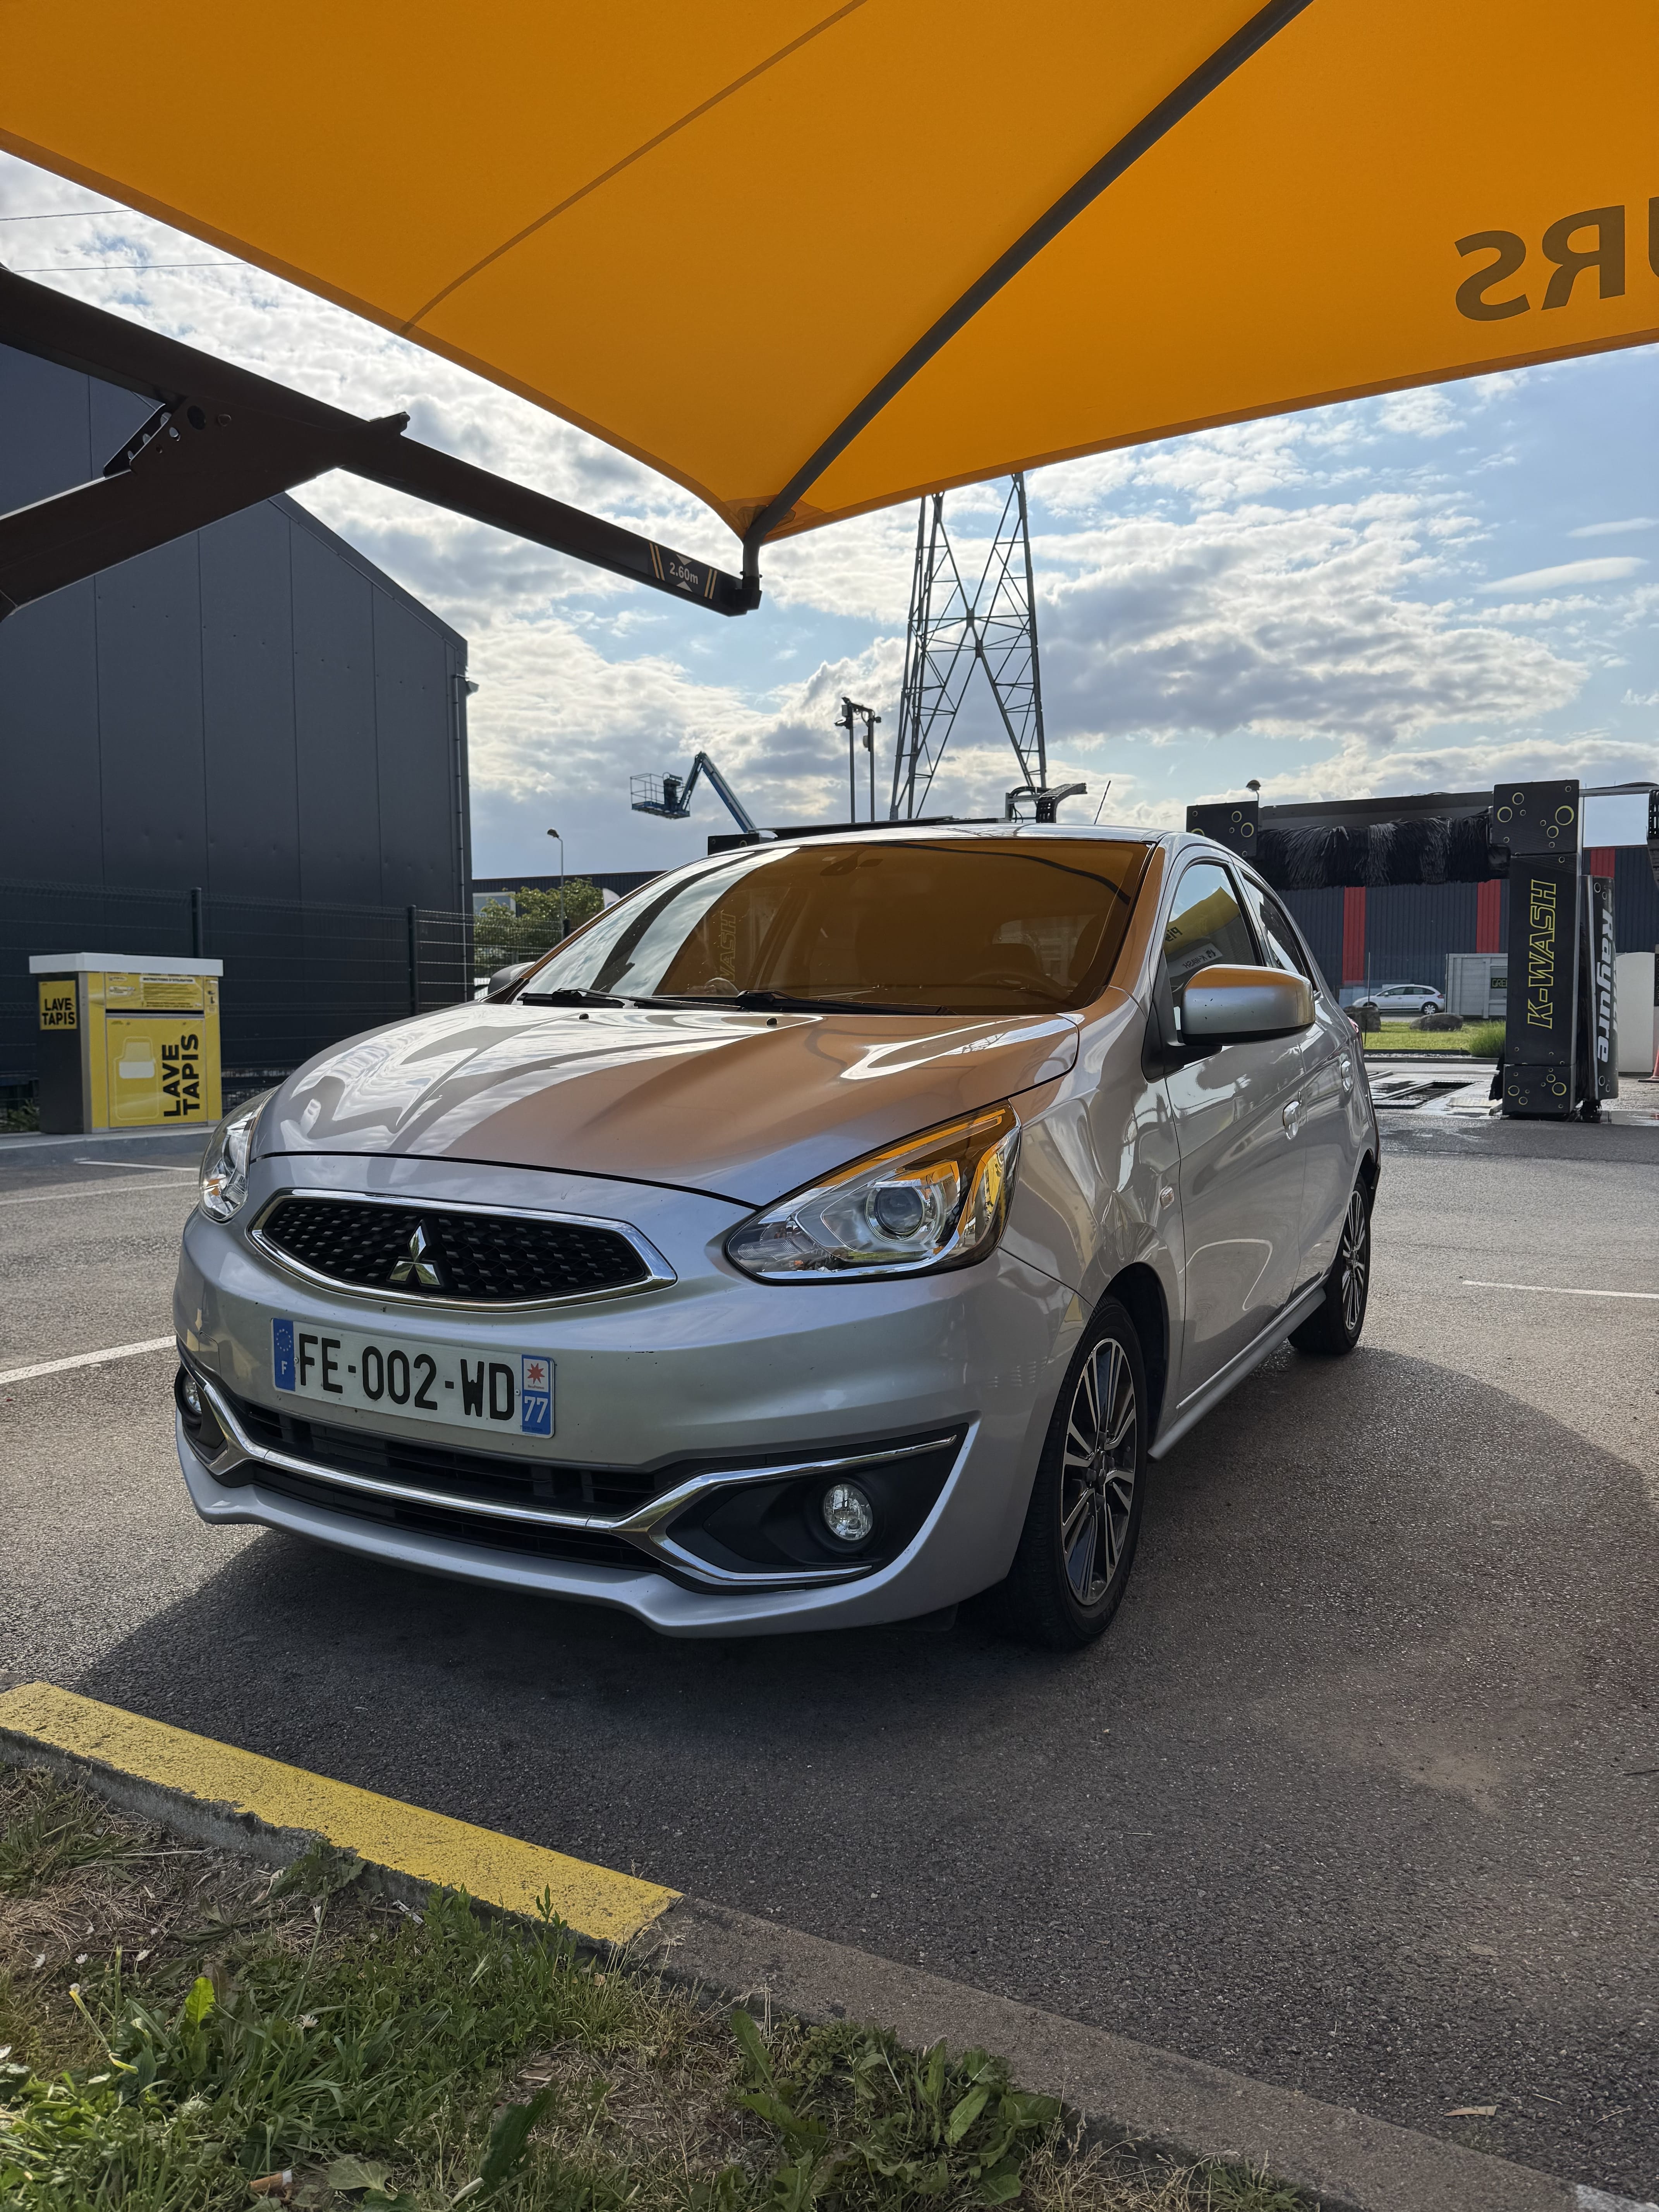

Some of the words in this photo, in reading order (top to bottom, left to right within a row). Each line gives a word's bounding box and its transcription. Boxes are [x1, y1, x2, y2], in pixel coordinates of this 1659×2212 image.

[670, 562, 699, 585] 2.60m
[1527, 878, 1557, 1030] K-WASH
[45, 998, 72, 1011] LAVE
[1597, 908, 1614, 1063] Rayure
[41, 1012, 76, 1025] TAPIS
[162, 1044, 181, 1117] LAVE
[180, 1034, 200, 1116] TAPIS
[281, 1360, 288, 1375] F
[299, 1333, 515, 1421] FE-002-WD
[524, 1396, 548, 1423] 77
